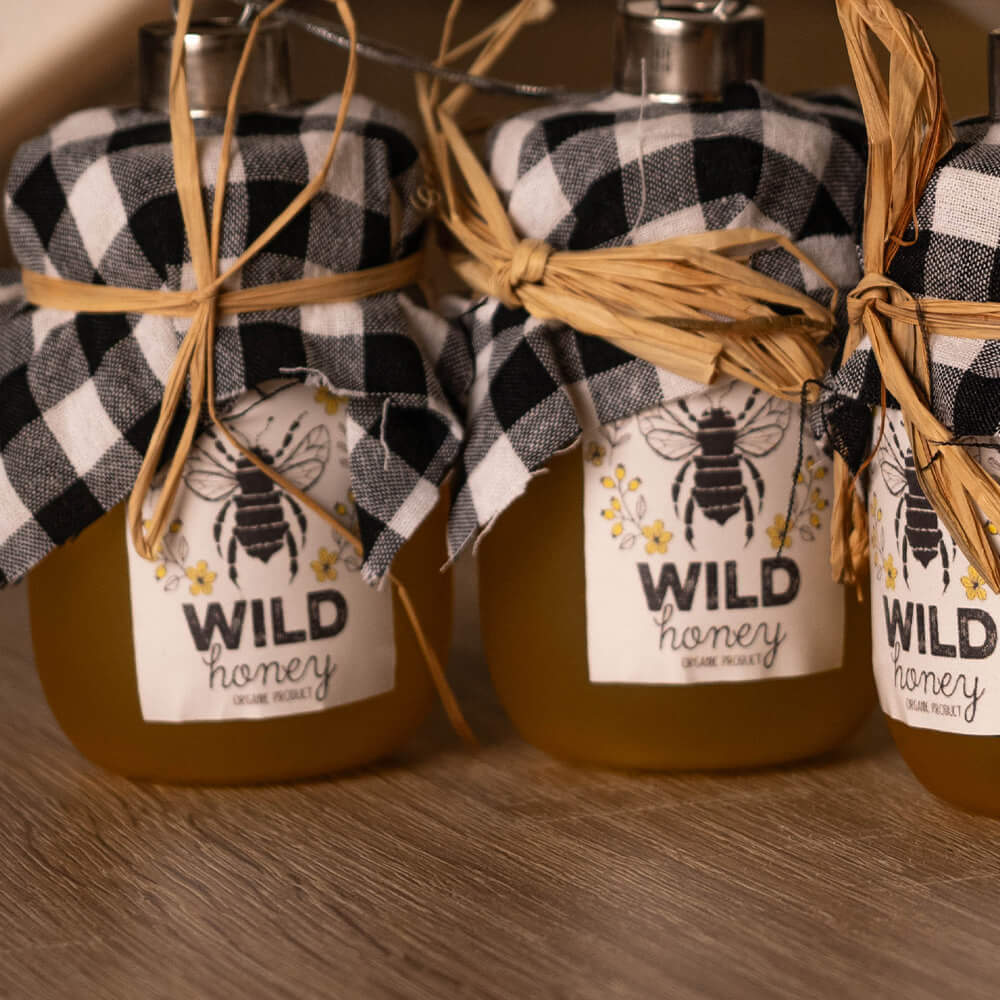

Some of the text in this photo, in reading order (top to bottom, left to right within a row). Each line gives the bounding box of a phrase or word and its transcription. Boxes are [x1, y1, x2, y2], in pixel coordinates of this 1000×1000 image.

[637, 556, 800, 612] WILD
[182, 589, 348, 651] WILD
[654, 603, 786, 669] honey
[883, 595, 998, 659] WILD
[203, 642, 336, 701] honey
[892, 641, 986, 723] honey
